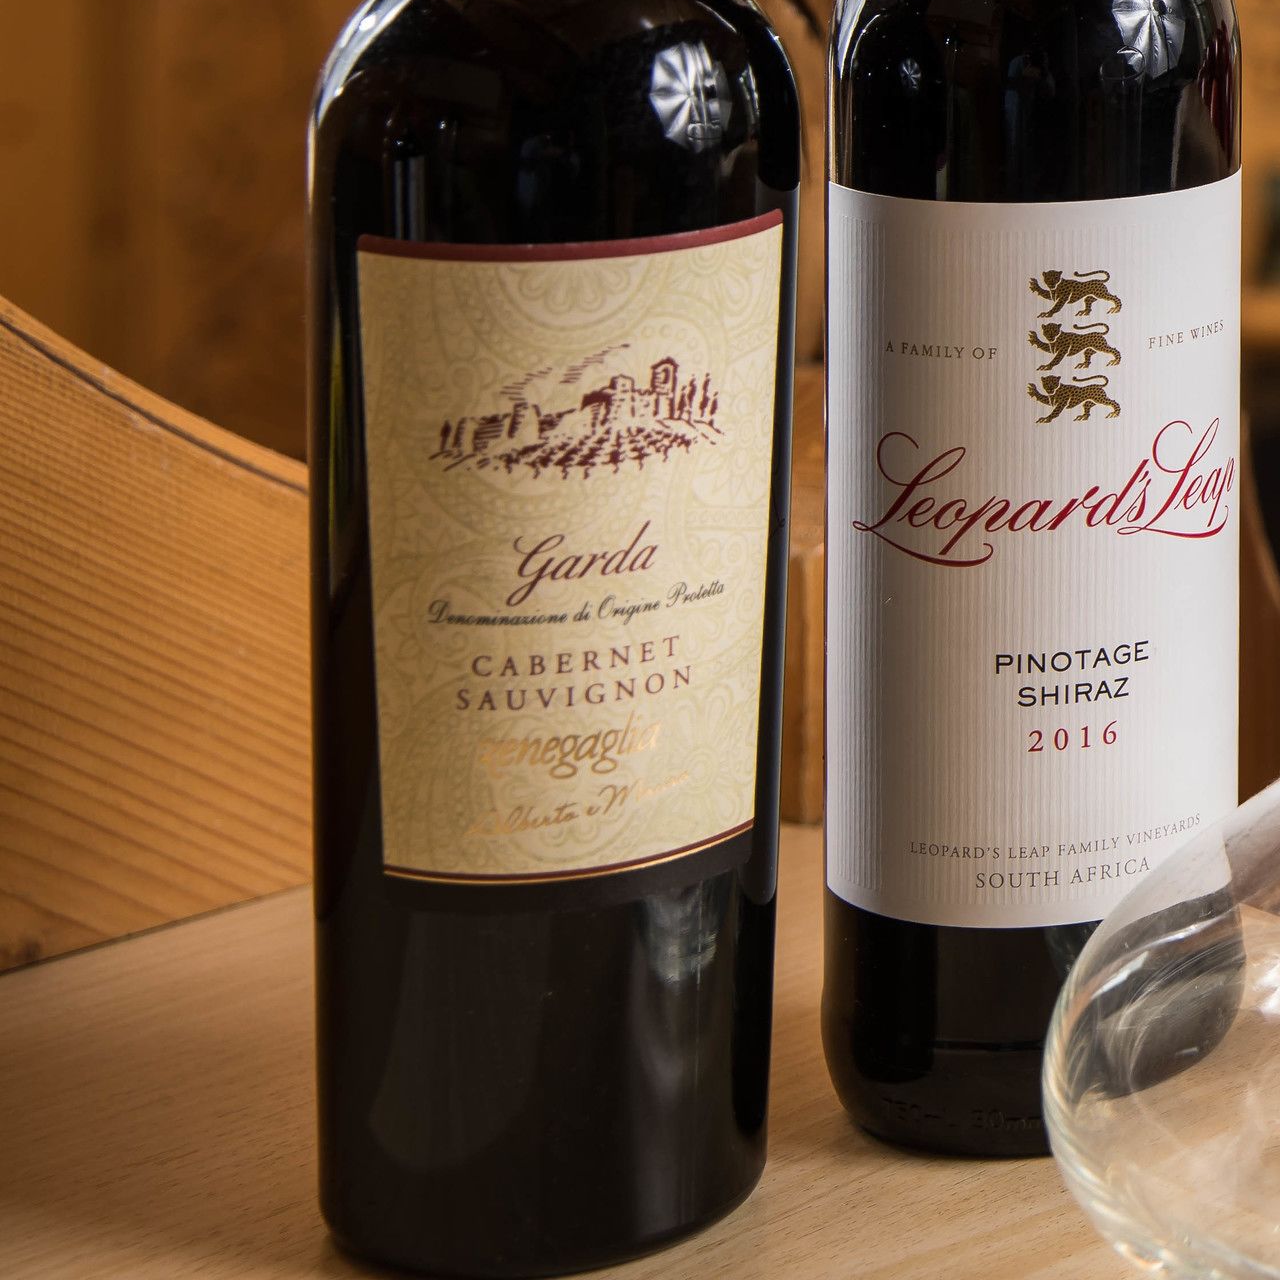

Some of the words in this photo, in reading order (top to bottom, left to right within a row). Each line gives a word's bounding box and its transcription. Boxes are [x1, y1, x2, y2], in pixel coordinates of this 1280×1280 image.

[884, 340, 896, 354] A
[901, 342, 965, 360] FAMILY
[972, 346, 998, 361] OF
[1148, 331, 1184, 350] FINE
[1190, 319, 1225, 341] WINES
[852, 431, 1151, 568] Leopard's
[1117, 417, 1235, 539] Leap
[506, 520, 660, 607] Garda
[427, 598, 568, 627] Denominazione
[573, 601, 591, 622] di
[597, 593, 661, 626] Origine
[666, 579, 726, 609] Protetta
[471, 635, 681, 678] CABERNET
[994, 640, 1150, 675] PINOTAGE
[456, 665, 692, 711] SAUVIGNON
[1017, 676, 1130, 708] SHIRAZ
[1027, 719, 1118, 753] 2016
[909, 840, 1001, 860] LEOPARD'S
[1008, 845, 1051, 860] LEAP
[1057, 836, 1121, 857] FAMILY
[1125, 812, 1201, 845] VINEYARDS
[975, 870, 1060, 889] SOUTH
[1070, 856, 1151, 885] AFRICA
